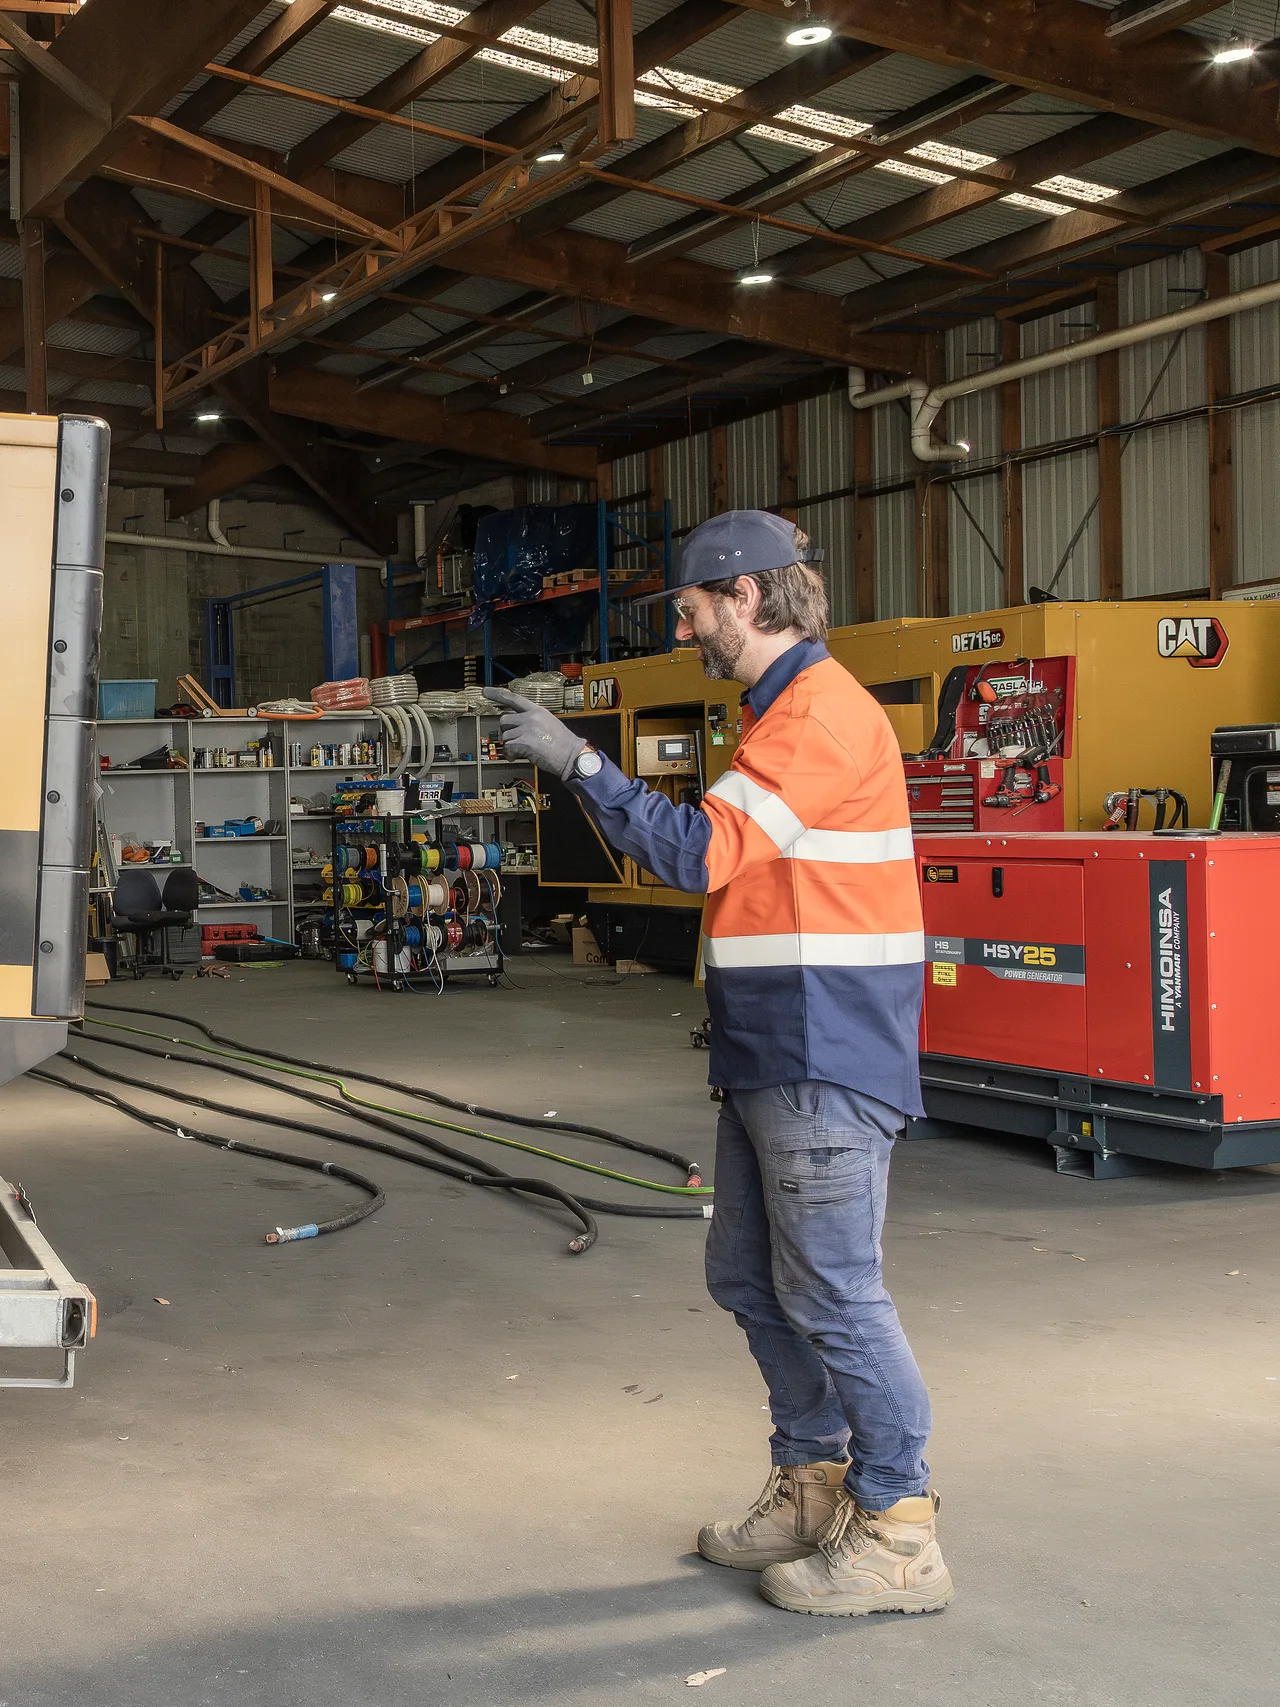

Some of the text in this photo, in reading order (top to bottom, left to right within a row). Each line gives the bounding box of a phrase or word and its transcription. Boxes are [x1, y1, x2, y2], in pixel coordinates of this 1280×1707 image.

[1260, 592, 1276, 600] LOAD
[952, 630, 991, 652] DE715
[1158, 618, 1211, 657] CAT
[590, 679, 614, 708] CAT
[1172, 911, 1181, 949] COMPANY
[934, 941, 949, 950] HS
[983, 943, 1057, 966] HSY25
[1158, 887, 1175, 1032] HIMOINSA
[1004, 970, 1063, 982] POWER GENERATOR
[1174, 953, 1183, 999] YANMAR
